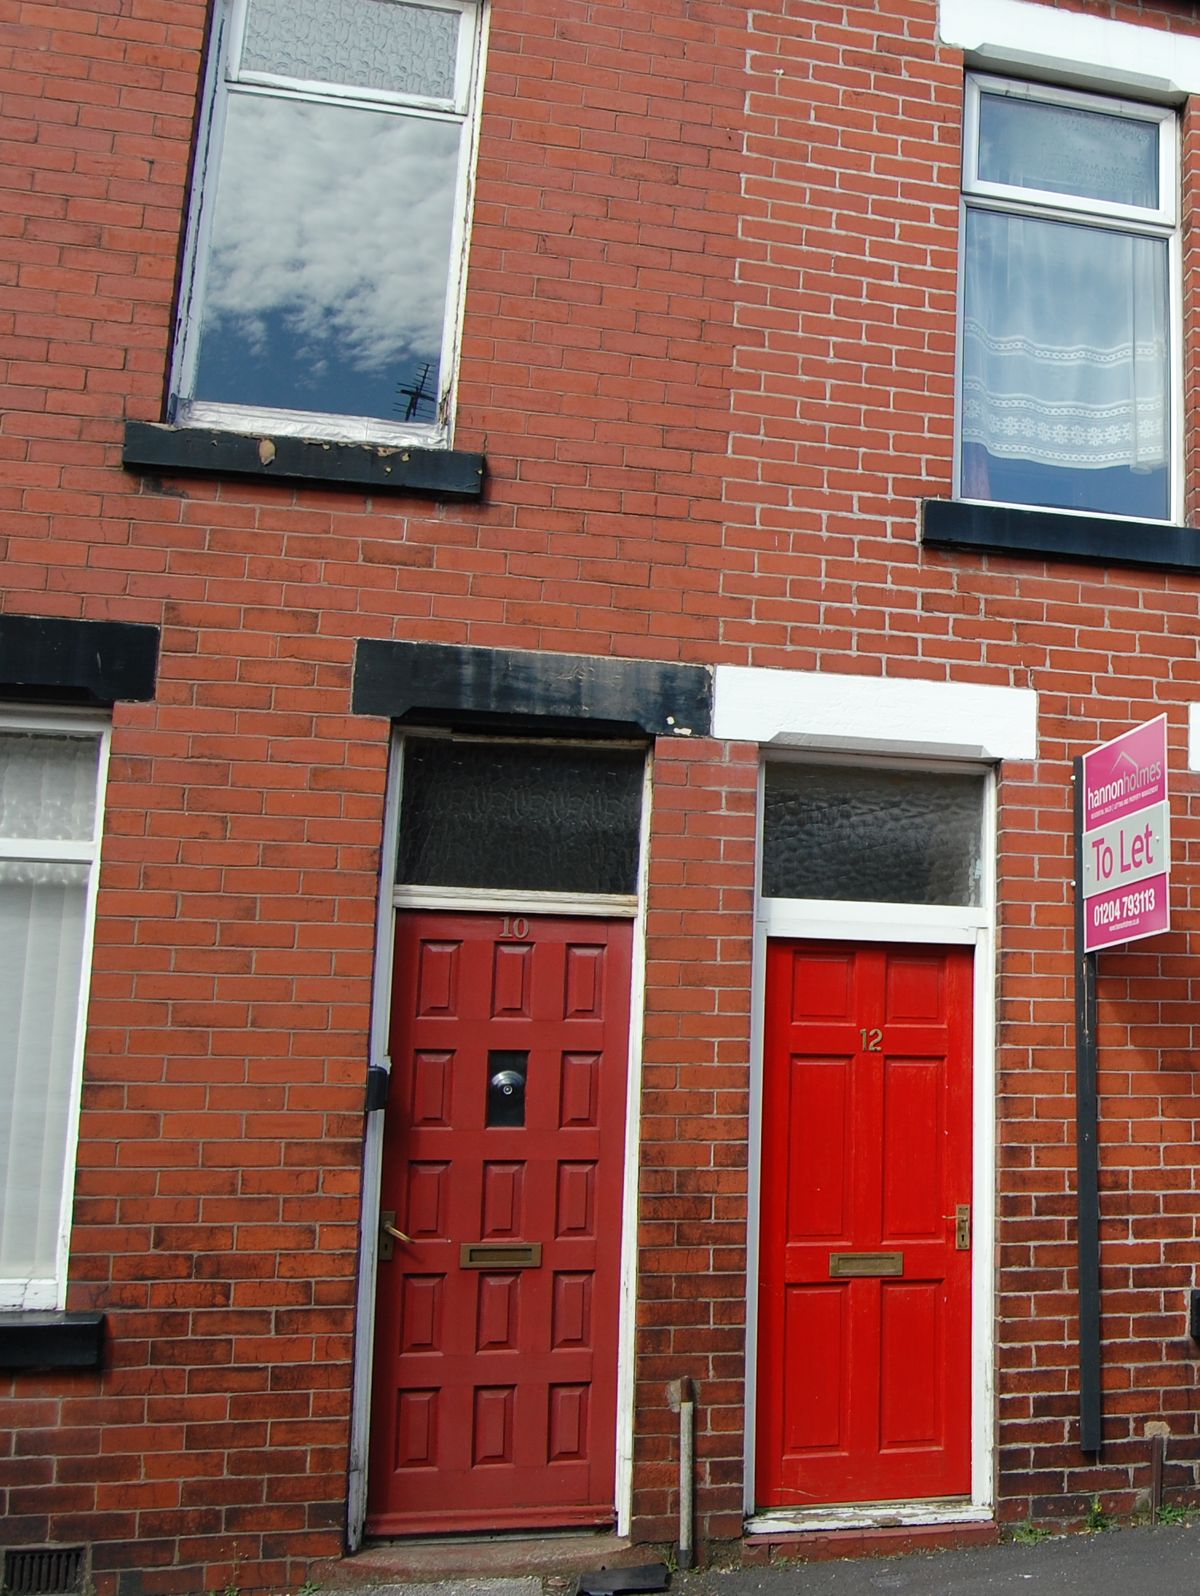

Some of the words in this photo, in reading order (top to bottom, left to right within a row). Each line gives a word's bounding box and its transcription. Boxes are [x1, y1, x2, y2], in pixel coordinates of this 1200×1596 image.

[1092, 837, 1113, 881] To
[1120, 822, 1153, 873] Let
[1094, 898, 1121, 927] 01204
[1122, 888, 1155, 918] 793113
[499, 916, 529, 939] 10
[860, 1028, 882, 1051] 12
